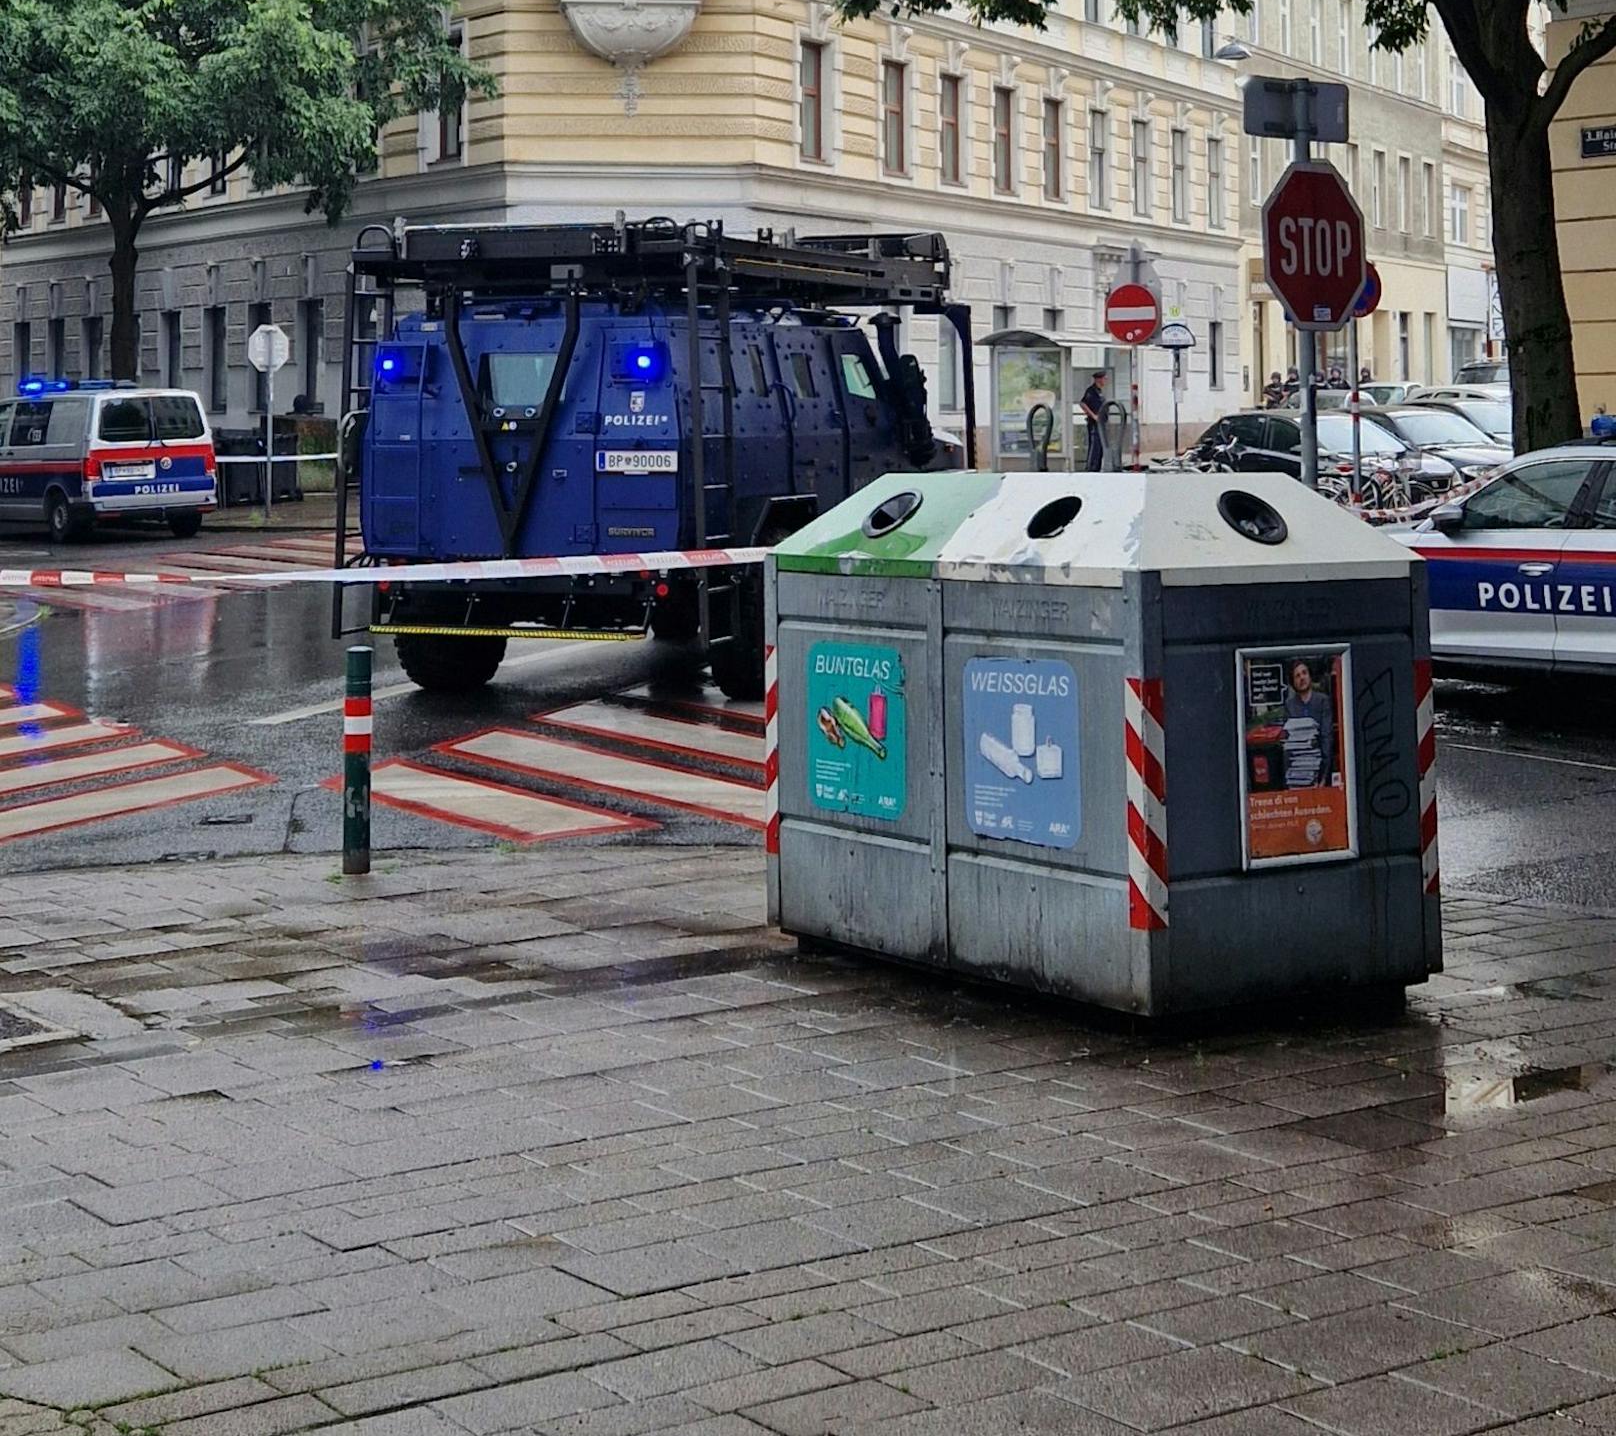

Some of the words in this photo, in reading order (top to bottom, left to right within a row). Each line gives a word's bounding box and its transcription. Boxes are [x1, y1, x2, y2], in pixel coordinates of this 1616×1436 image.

[1279, 216, 1352, 278] STOP
[604, 415, 660, 426] POLIZEI
[608, 454, 623, 468] BP
[633, 454, 672, 468] 90006
[134, 483, 180, 495] POLIZEI
[1478, 582, 1612, 613] POLIZEI
[815, 654, 891, 680] BUNTGLAS
[971, 671, 1070, 697] WEISSGLAS
